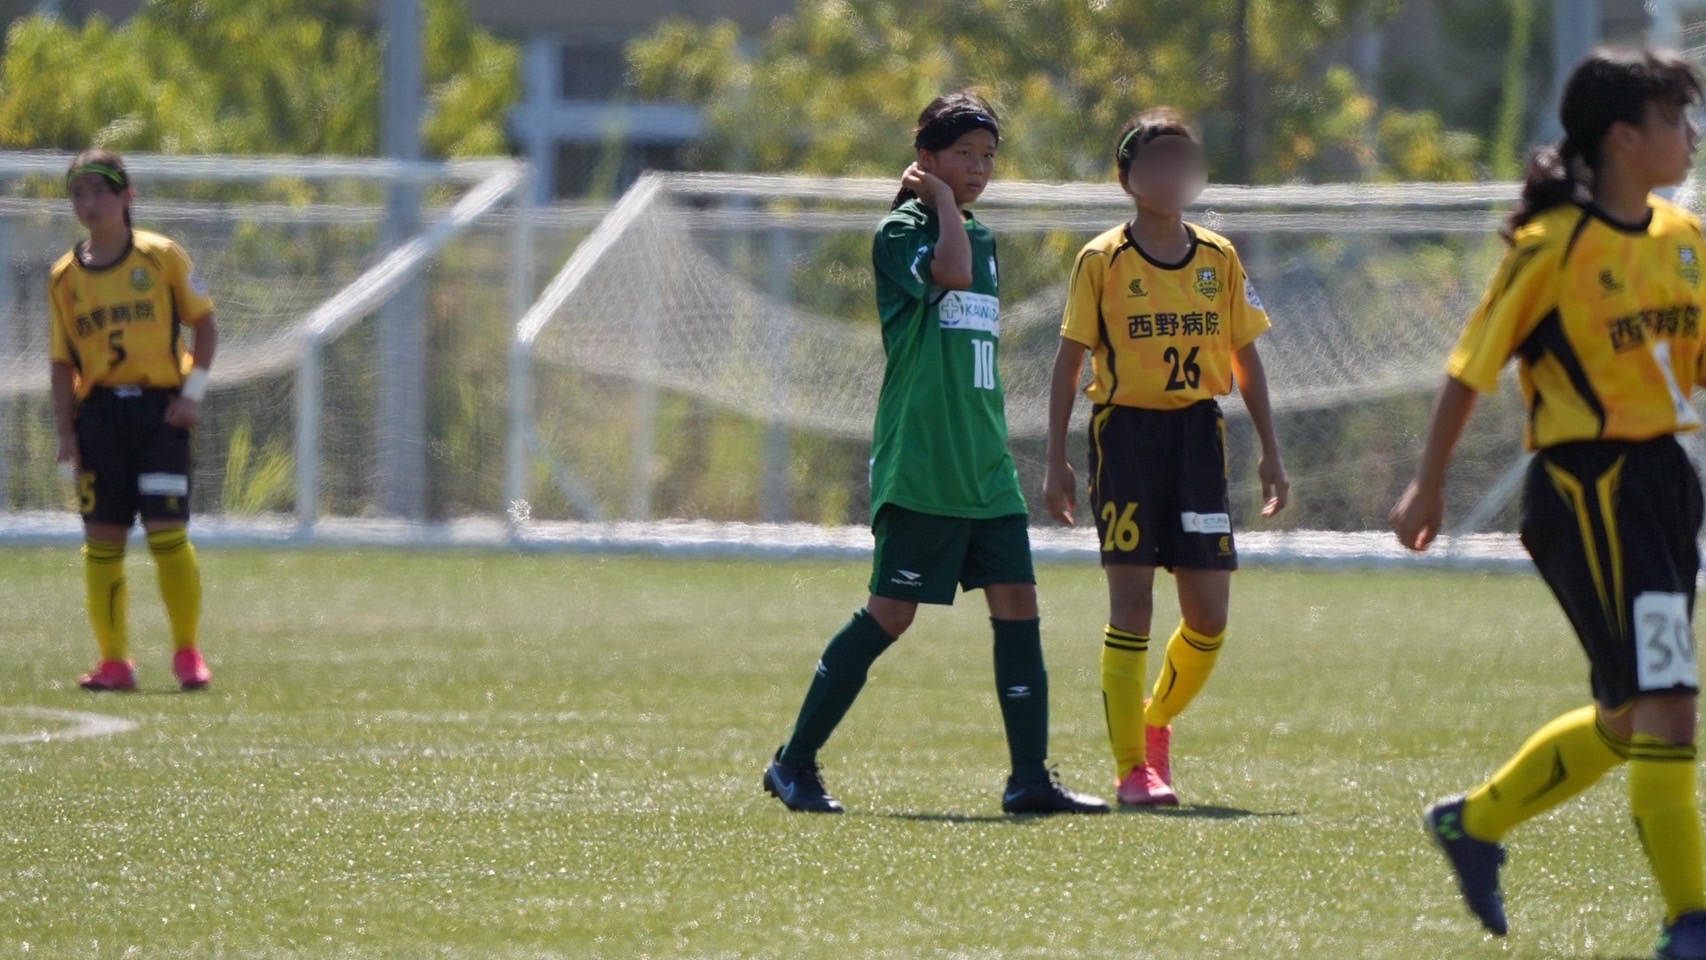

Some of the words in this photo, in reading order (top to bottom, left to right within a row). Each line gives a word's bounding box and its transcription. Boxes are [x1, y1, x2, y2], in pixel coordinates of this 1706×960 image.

[1127, 311, 1220, 339] 西野病院
[108, 330, 126, 368] 5
[971, 339, 995, 390] 10
[1163, 346, 1201, 391] 26
[1102, 501, 1140, 552] 26
